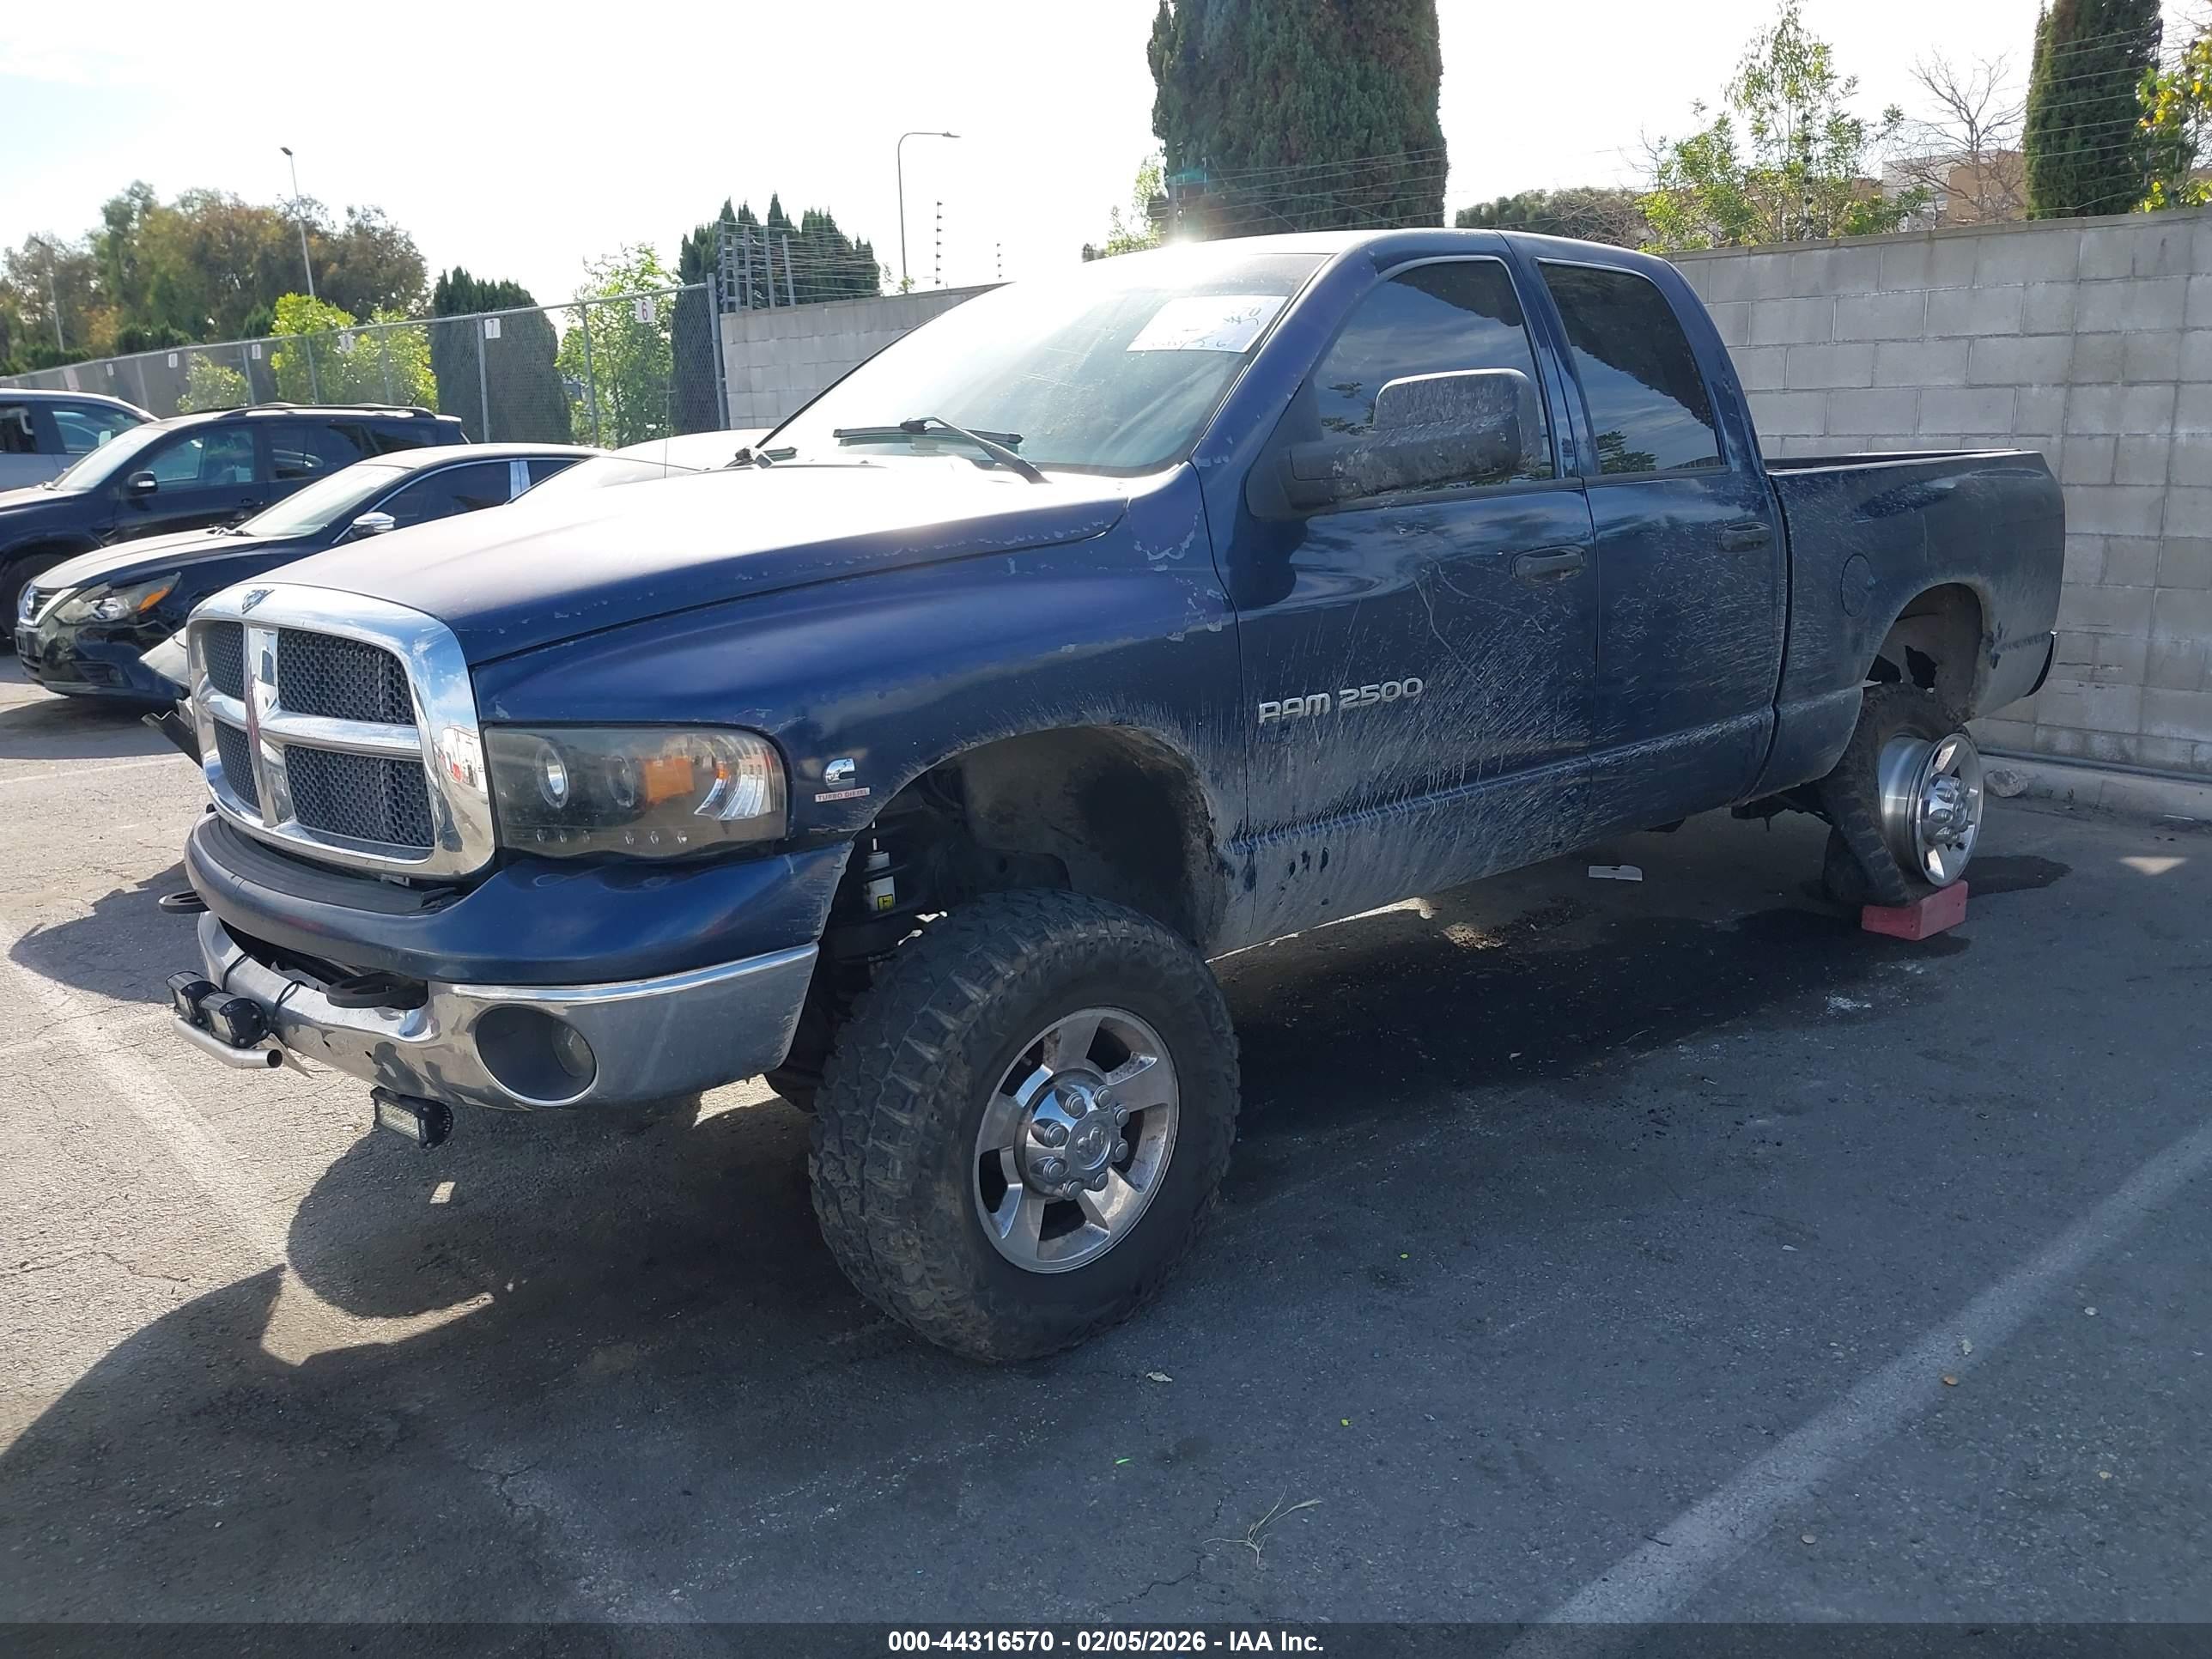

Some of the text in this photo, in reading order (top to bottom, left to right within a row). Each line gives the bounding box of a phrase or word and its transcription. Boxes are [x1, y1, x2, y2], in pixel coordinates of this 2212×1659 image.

[641, 301, 648, 320] 6
[1259, 678, 1424, 723] RAM 2500
[817, 789, 867, 801] TURBO DIESEL
